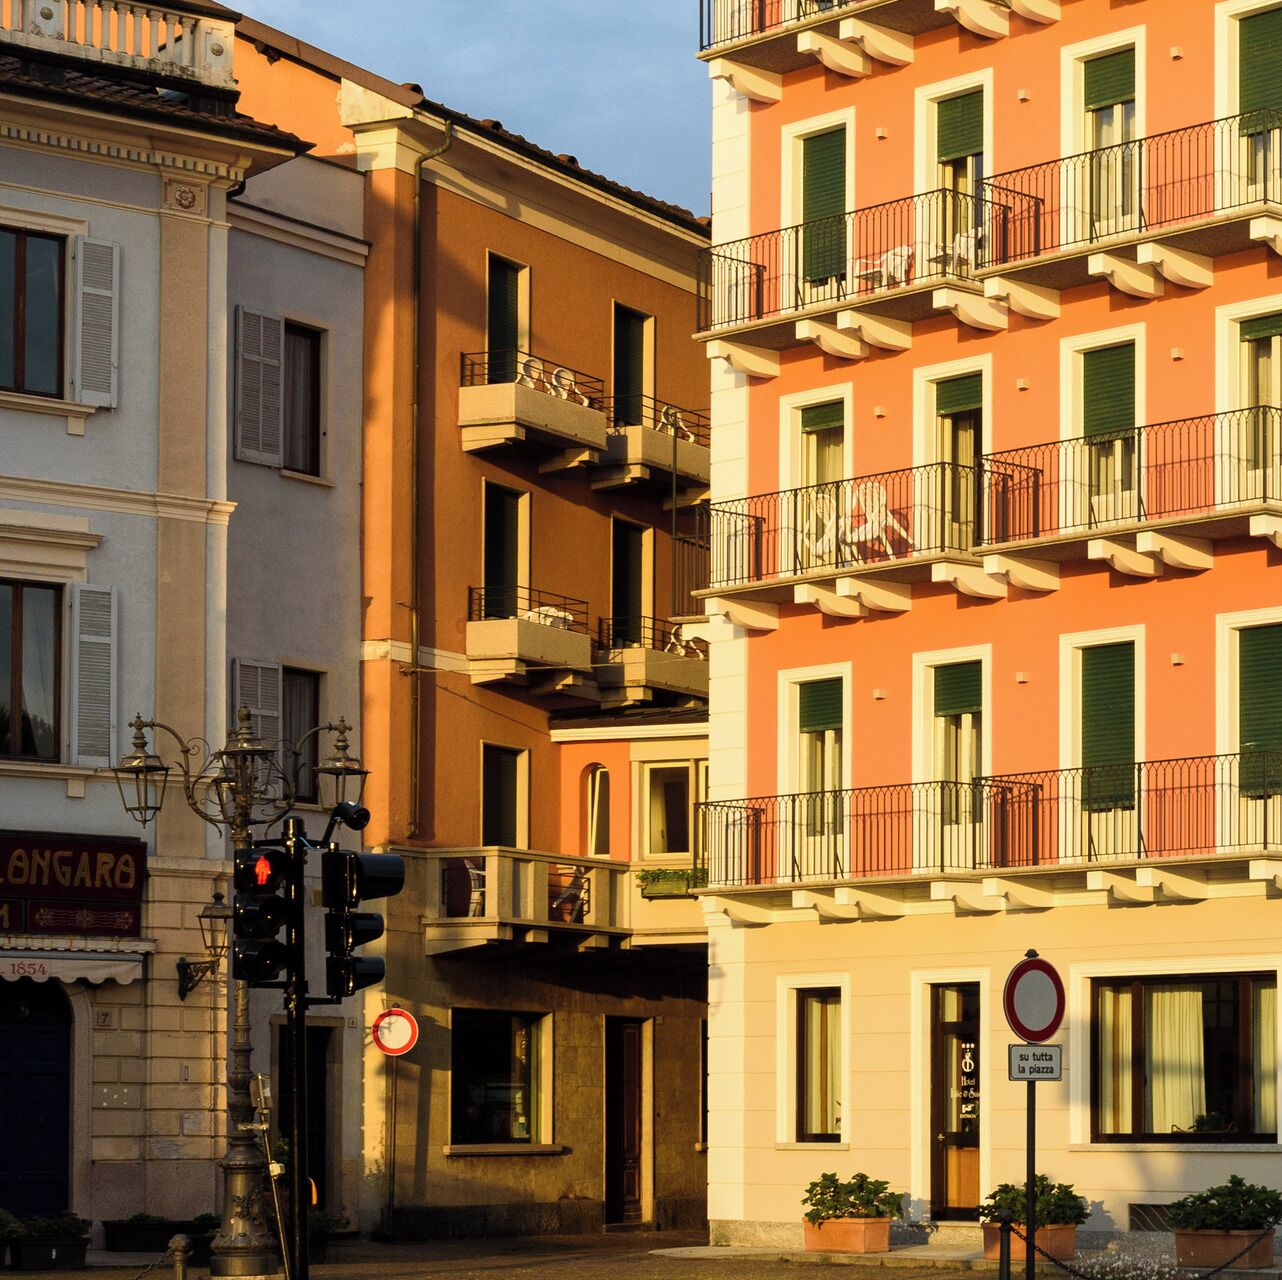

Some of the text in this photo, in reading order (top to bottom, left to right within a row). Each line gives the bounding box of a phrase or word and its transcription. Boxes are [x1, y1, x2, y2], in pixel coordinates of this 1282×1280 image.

[0, 848, 136, 889] ONGARO
[10, 961, 48, 976] 1854
[101, 1012, 109, 1024] 7
[1019, 1051, 1054, 1062] su tutta
[1018, 1063, 1054, 1076] la piazza
